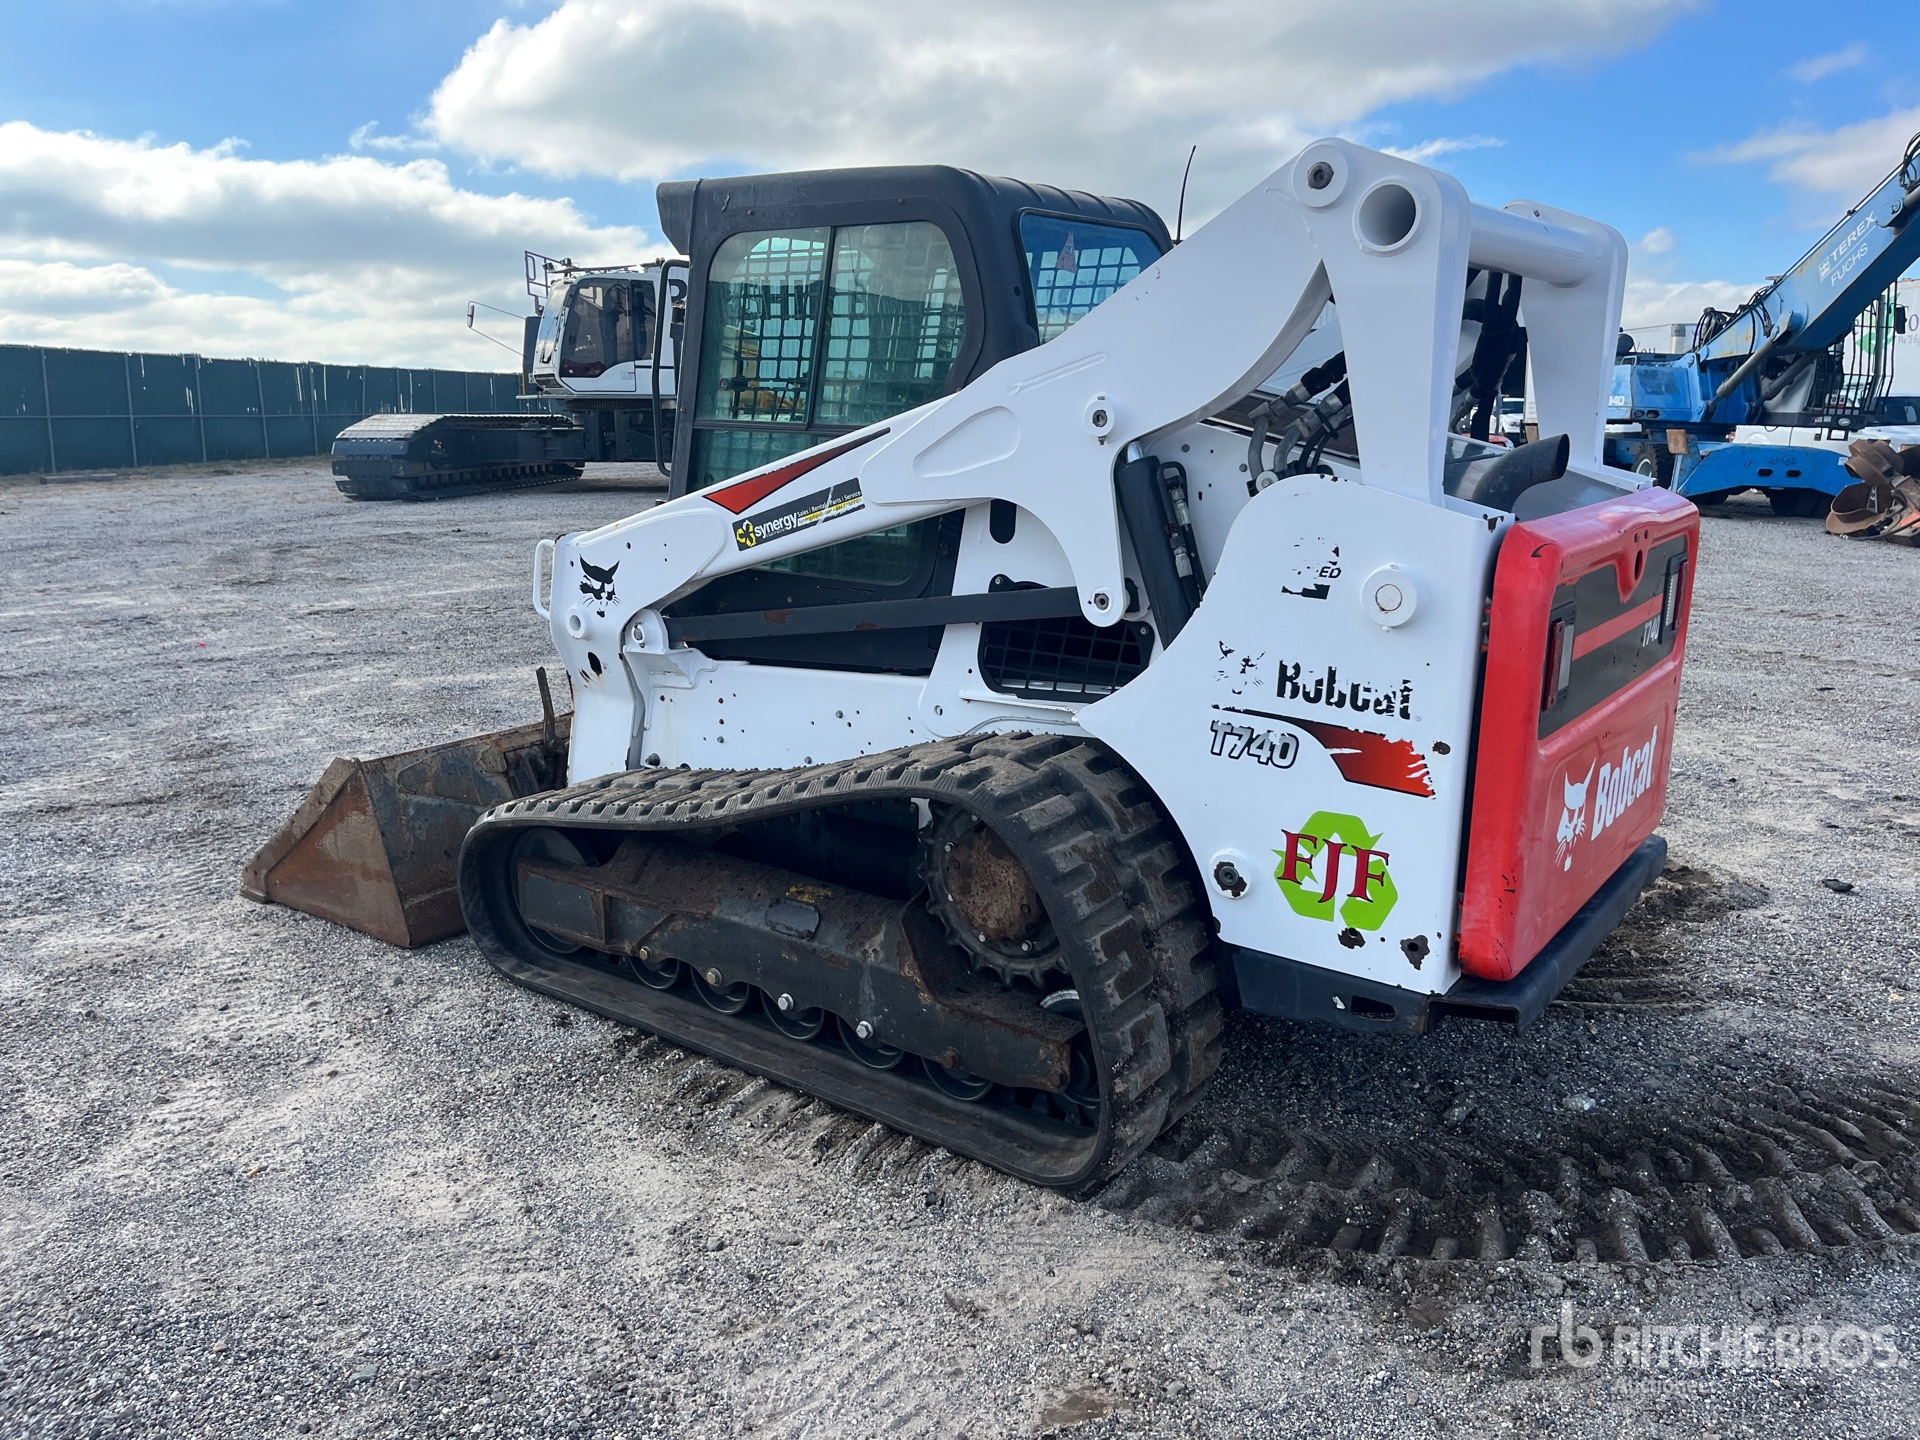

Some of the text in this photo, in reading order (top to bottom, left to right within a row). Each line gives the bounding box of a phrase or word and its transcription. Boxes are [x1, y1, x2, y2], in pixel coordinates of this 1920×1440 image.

[1830, 211, 1877, 261] TEREX
[1831, 242, 1868, 287] FUCHS
[754, 512, 797, 538] synergy
[1210, 720, 1299, 768] T740
[1591, 725, 1658, 841] Bobcat
[1277, 829, 1390, 903] FJF
